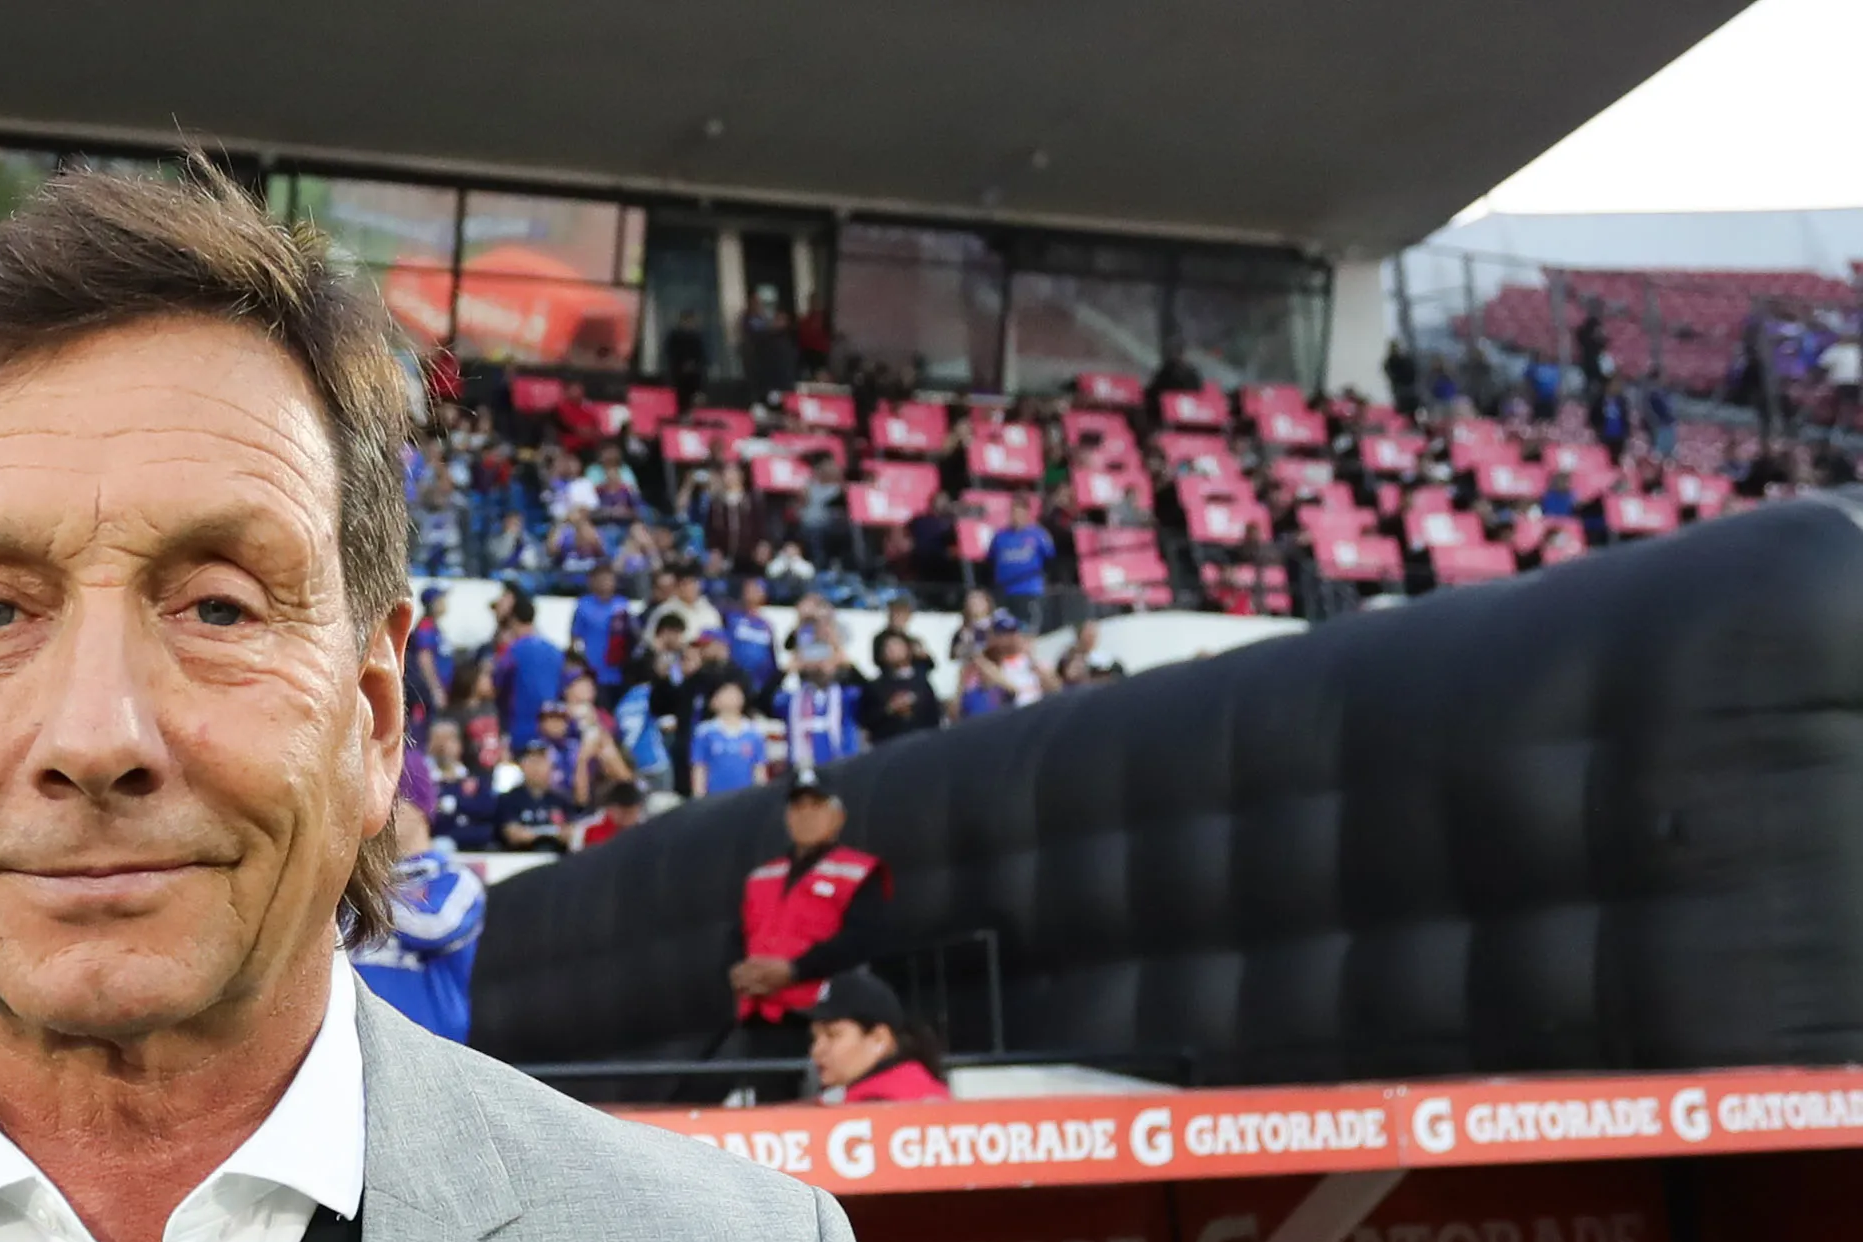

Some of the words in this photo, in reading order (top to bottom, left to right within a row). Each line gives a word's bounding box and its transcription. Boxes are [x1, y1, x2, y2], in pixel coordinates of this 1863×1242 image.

[690, 1130, 813, 1172] ADE
[827, 1119, 876, 1179] G
[889, 1119, 1117, 1168] GATORADE
[1130, 1109, 1174, 1166] G
[1185, 1110, 1387, 1154] GATORADE
[1413, 1098, 1456, 1153] G
[1466, 1097, 1662, 1143] GATORADE
[1671, 1088, 1711, 1141] G
